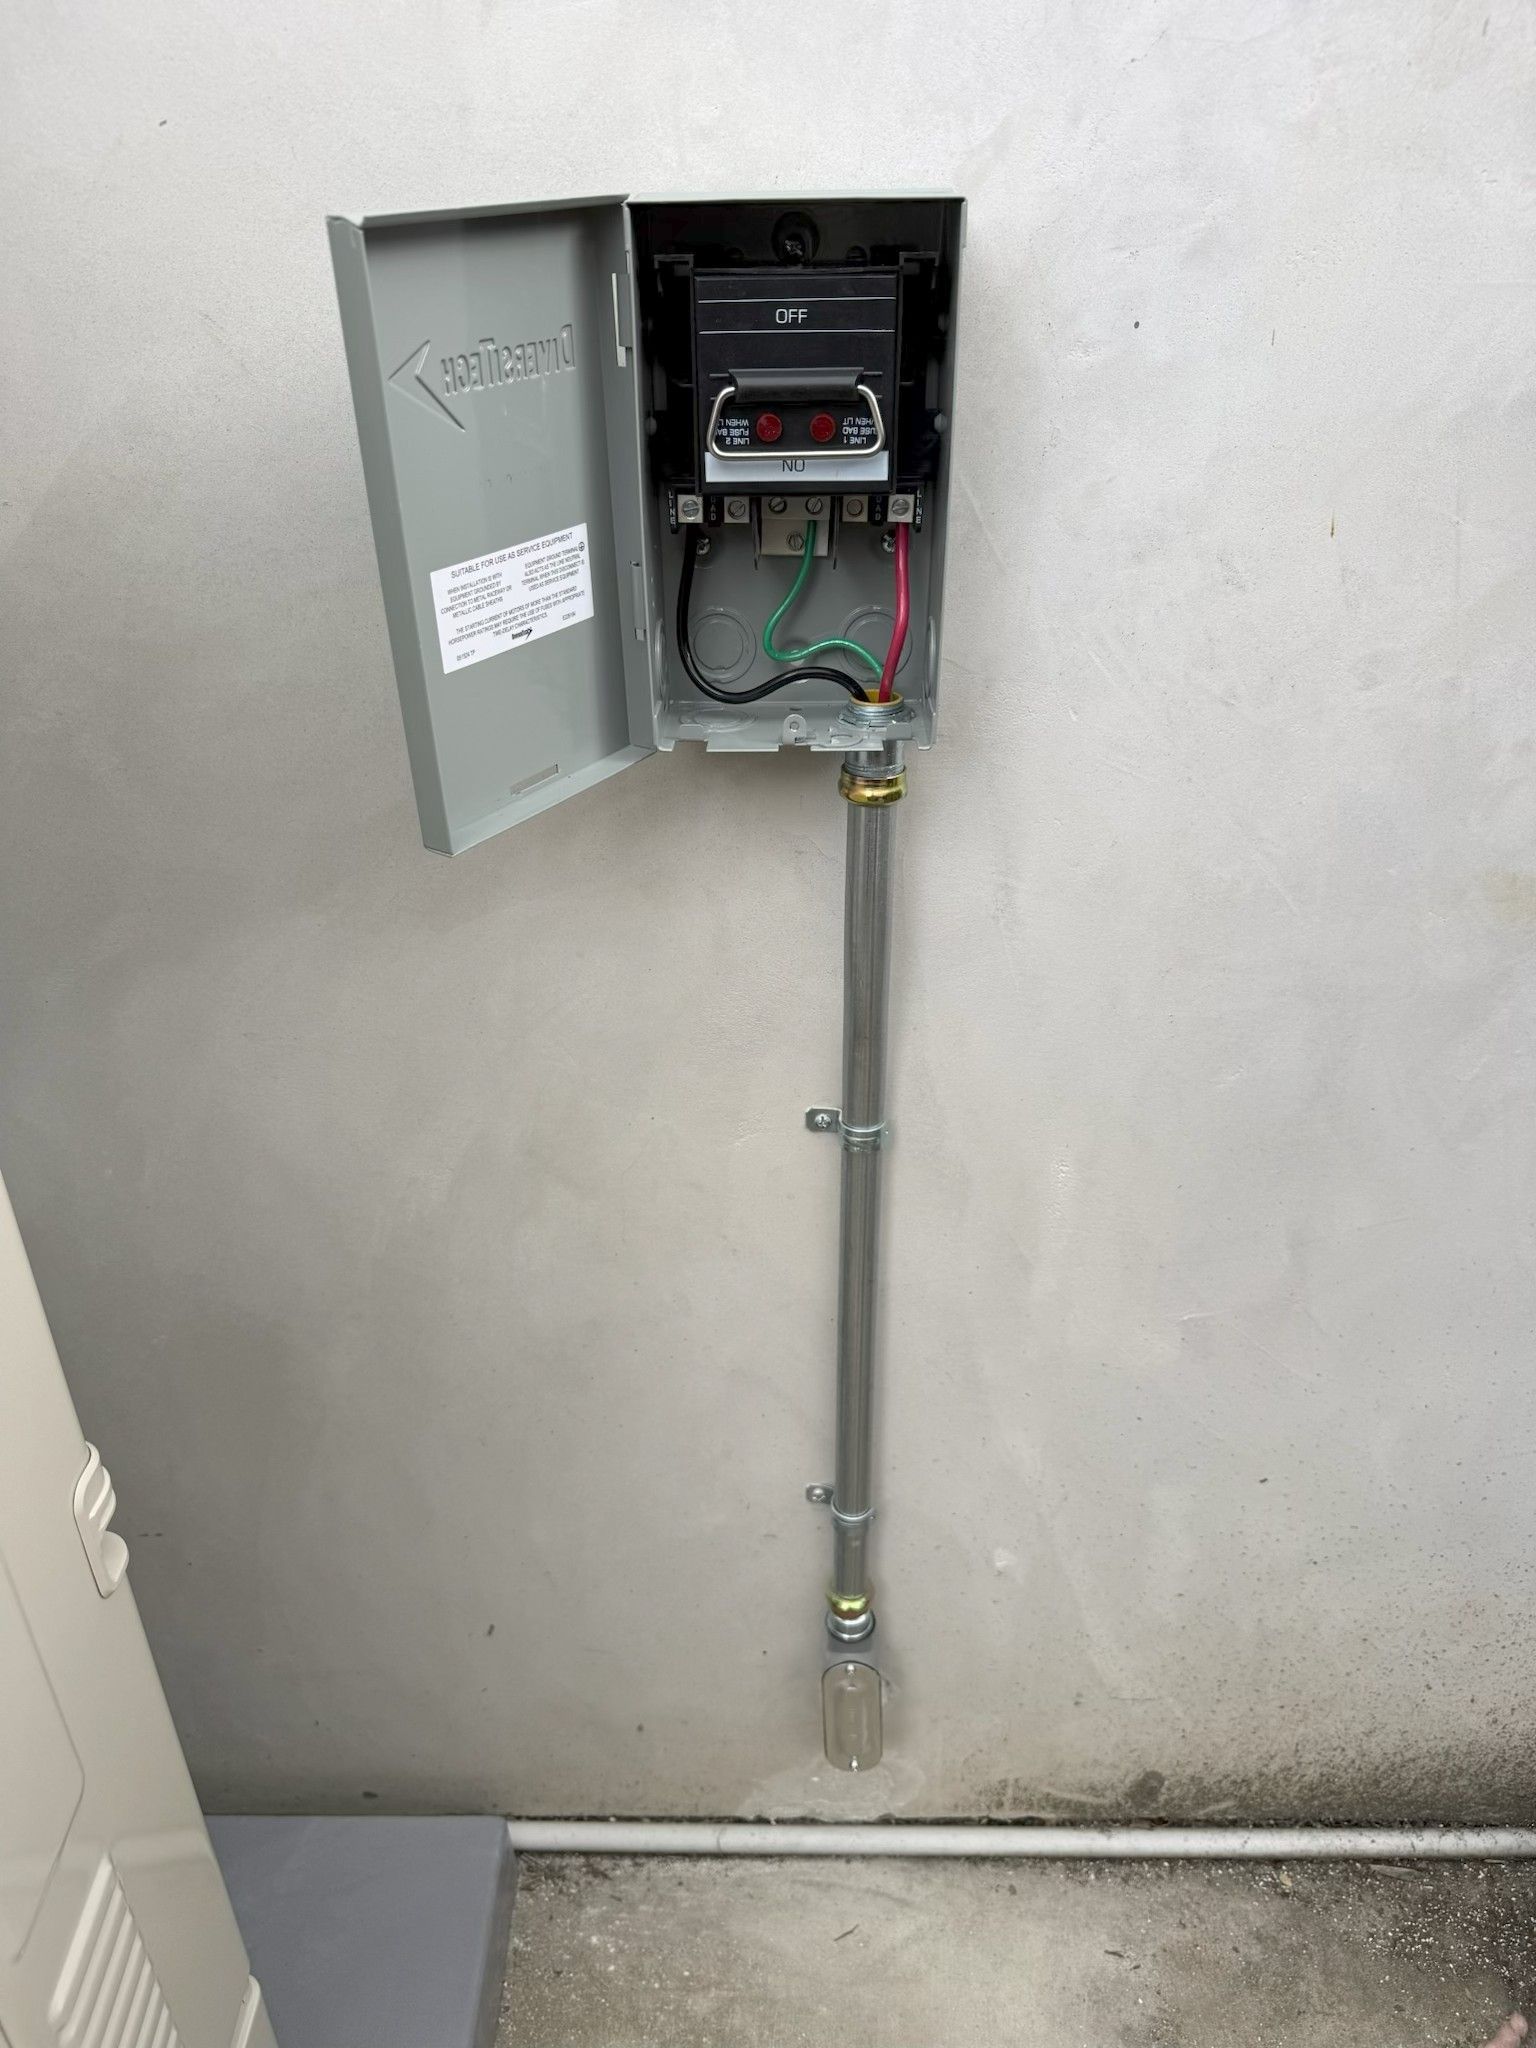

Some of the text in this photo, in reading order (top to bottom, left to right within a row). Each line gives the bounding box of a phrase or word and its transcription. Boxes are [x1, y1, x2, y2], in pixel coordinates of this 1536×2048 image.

[775, 308, 808, 324] OFF
[726, 418, 749, 426] WHEN
[842, 417, 854, 425] LIT
[729, 428, 749, 436] FUSE
[842, 426, 878, 436] USE BAD
[726, 437, 731, 445] 2
[782, 460, 806, 472] ON
[668, 491, 676, 525] LINE
[451, 532, 572, 578] SUITABLE FOR USE AS SERVICE EQUIPMENT
[441, 601, 467, 614] CONNECTION
[474, 595, 486, 603] METAL
